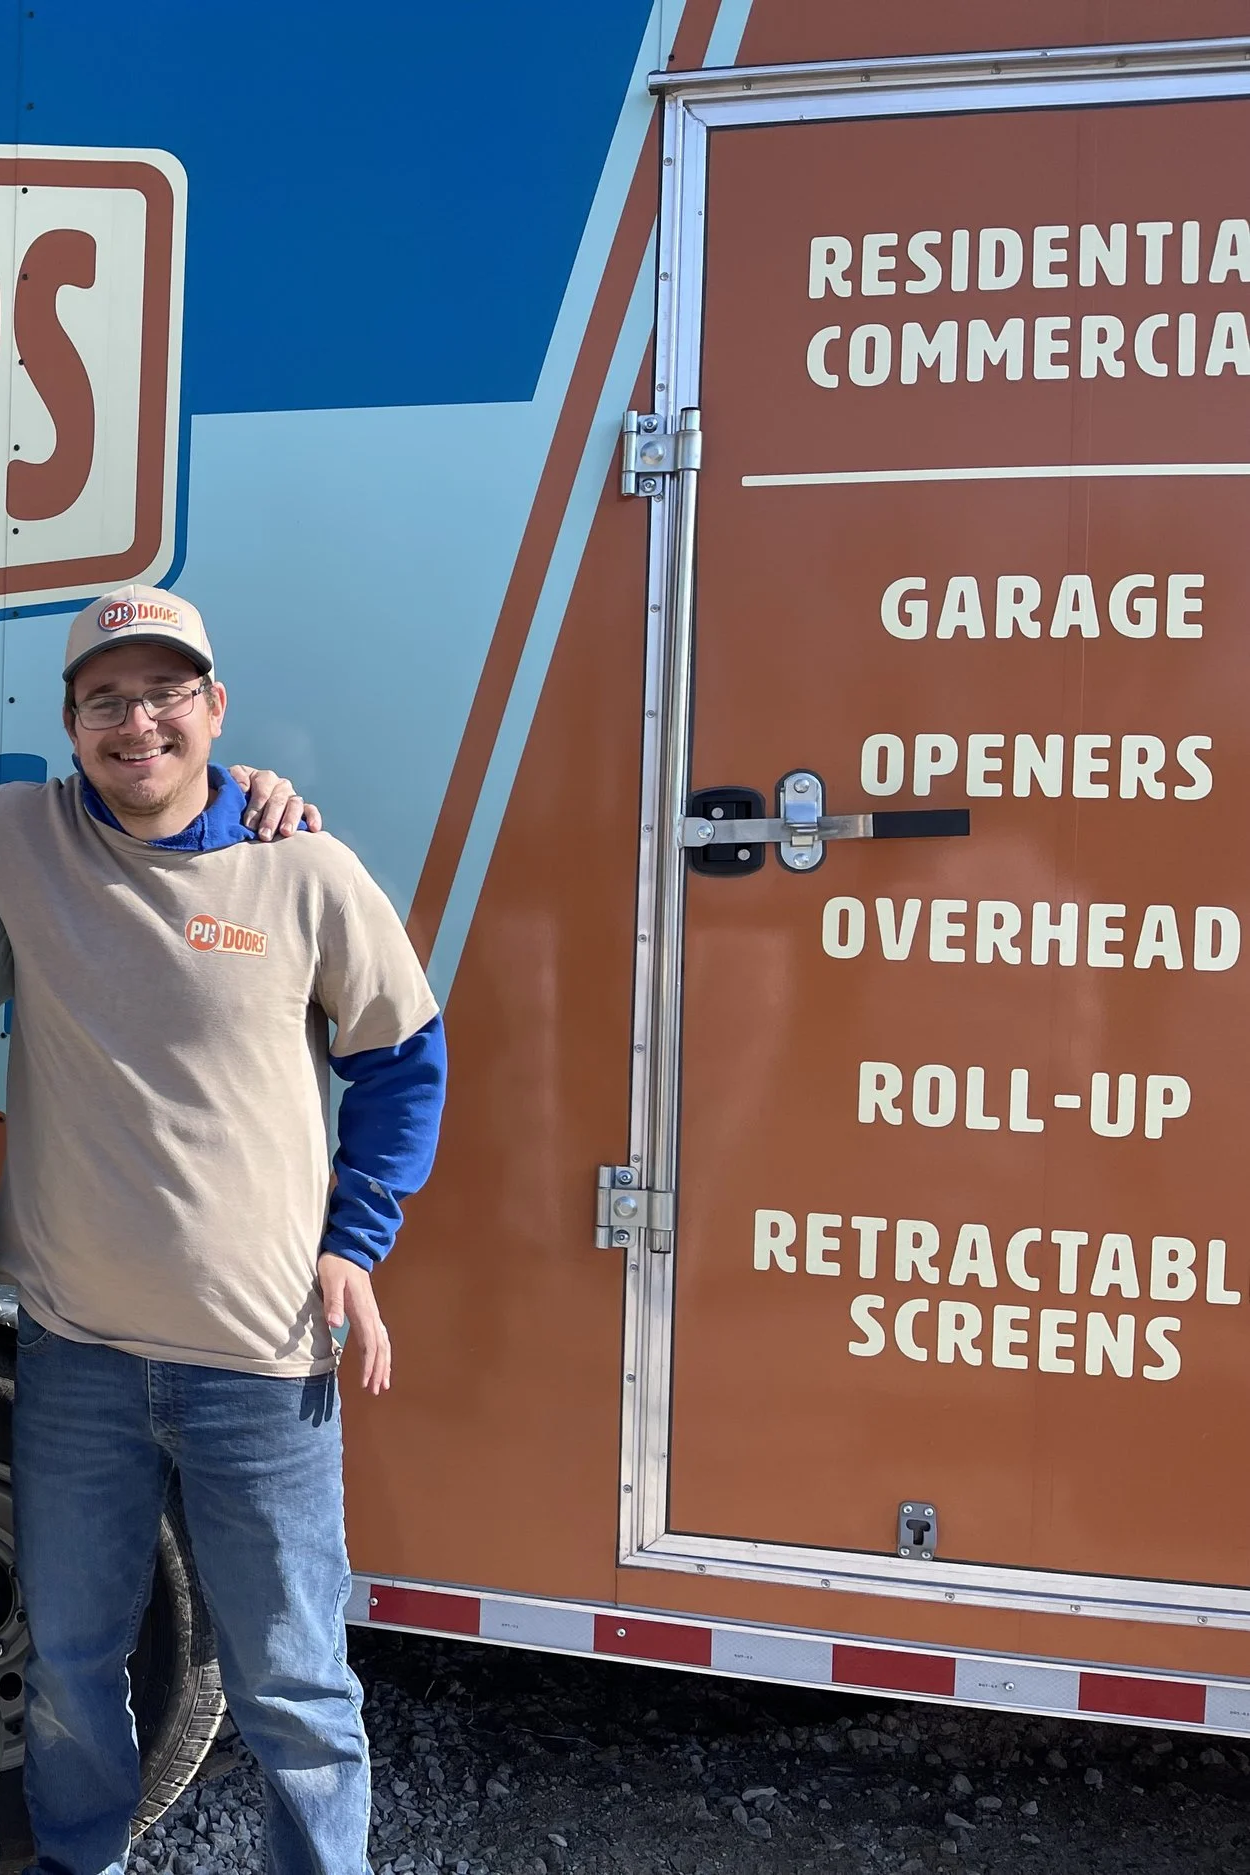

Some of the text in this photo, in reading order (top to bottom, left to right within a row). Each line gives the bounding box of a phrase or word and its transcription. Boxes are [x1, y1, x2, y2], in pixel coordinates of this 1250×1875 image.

[137, 603, 178, 624] DOORS
[880, 573, 1205, 640] GARAGE
[860, 733, 1213, 801] OPENERS
[222, 925, 265, 953] DOORS
[822, 896, 1241, 972] OVERHEAD
[858, 1061, 1191, 1140] ROLL-UP
[753, 1209, 1250, 1305] RETRACTABL
[848, 1293, 1181, 1381] SCREENS
